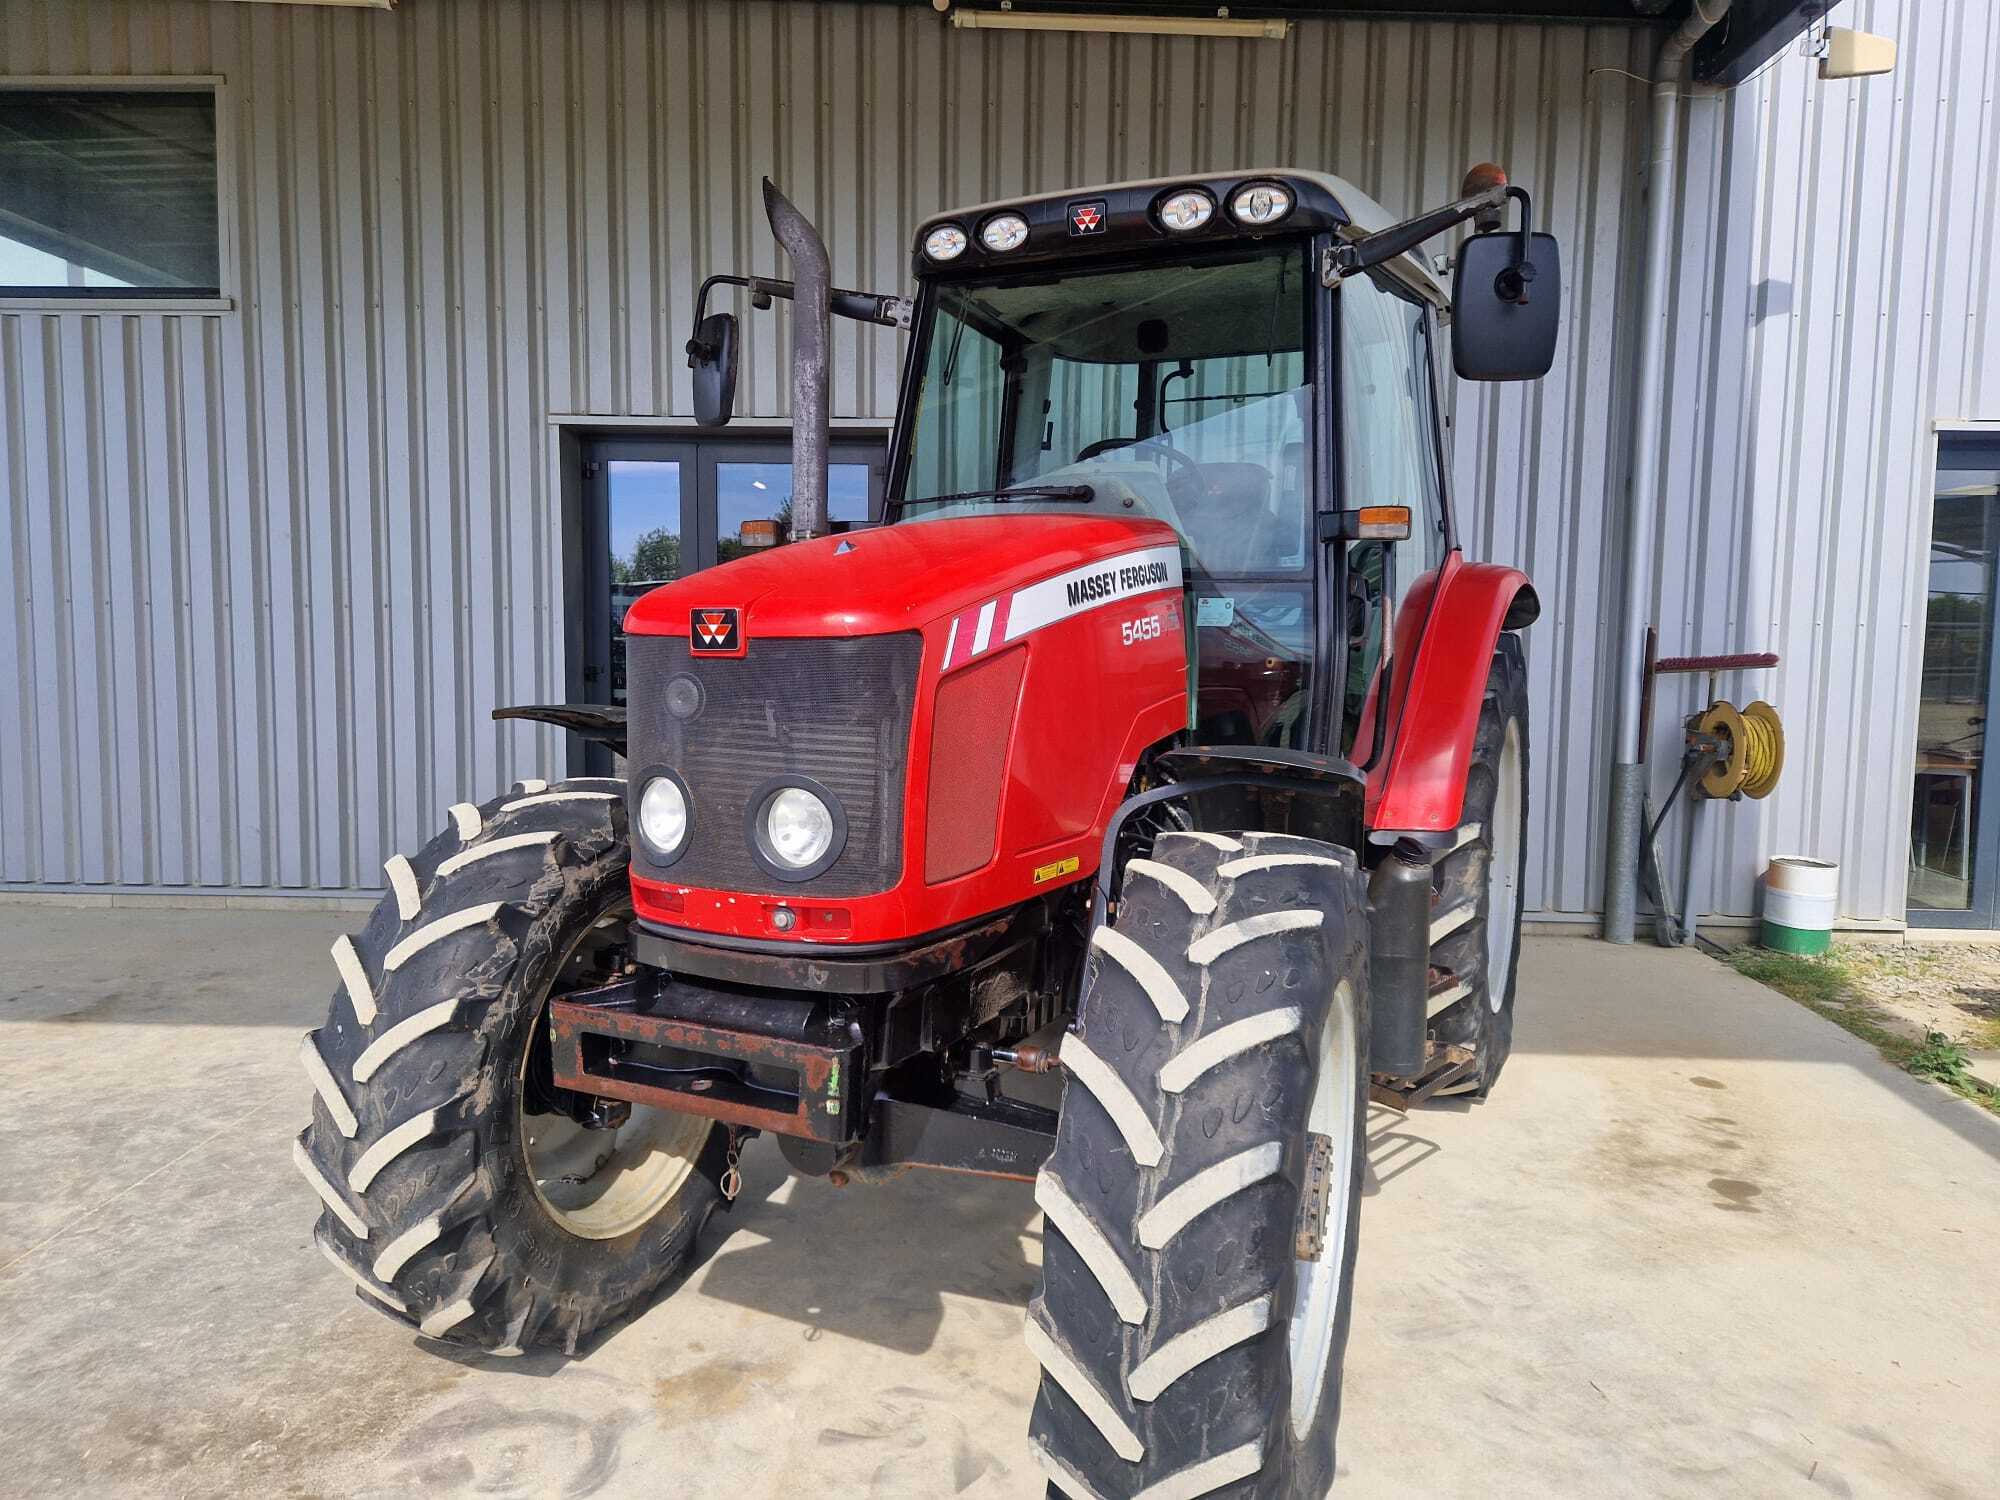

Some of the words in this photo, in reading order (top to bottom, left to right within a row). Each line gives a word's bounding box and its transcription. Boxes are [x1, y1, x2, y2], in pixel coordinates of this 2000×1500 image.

[1066, 571, 1117, 607] MASSEY
[1120, 561, 1168, 591] FERGUSON
[1122, 615, 1160, 645] 5455
